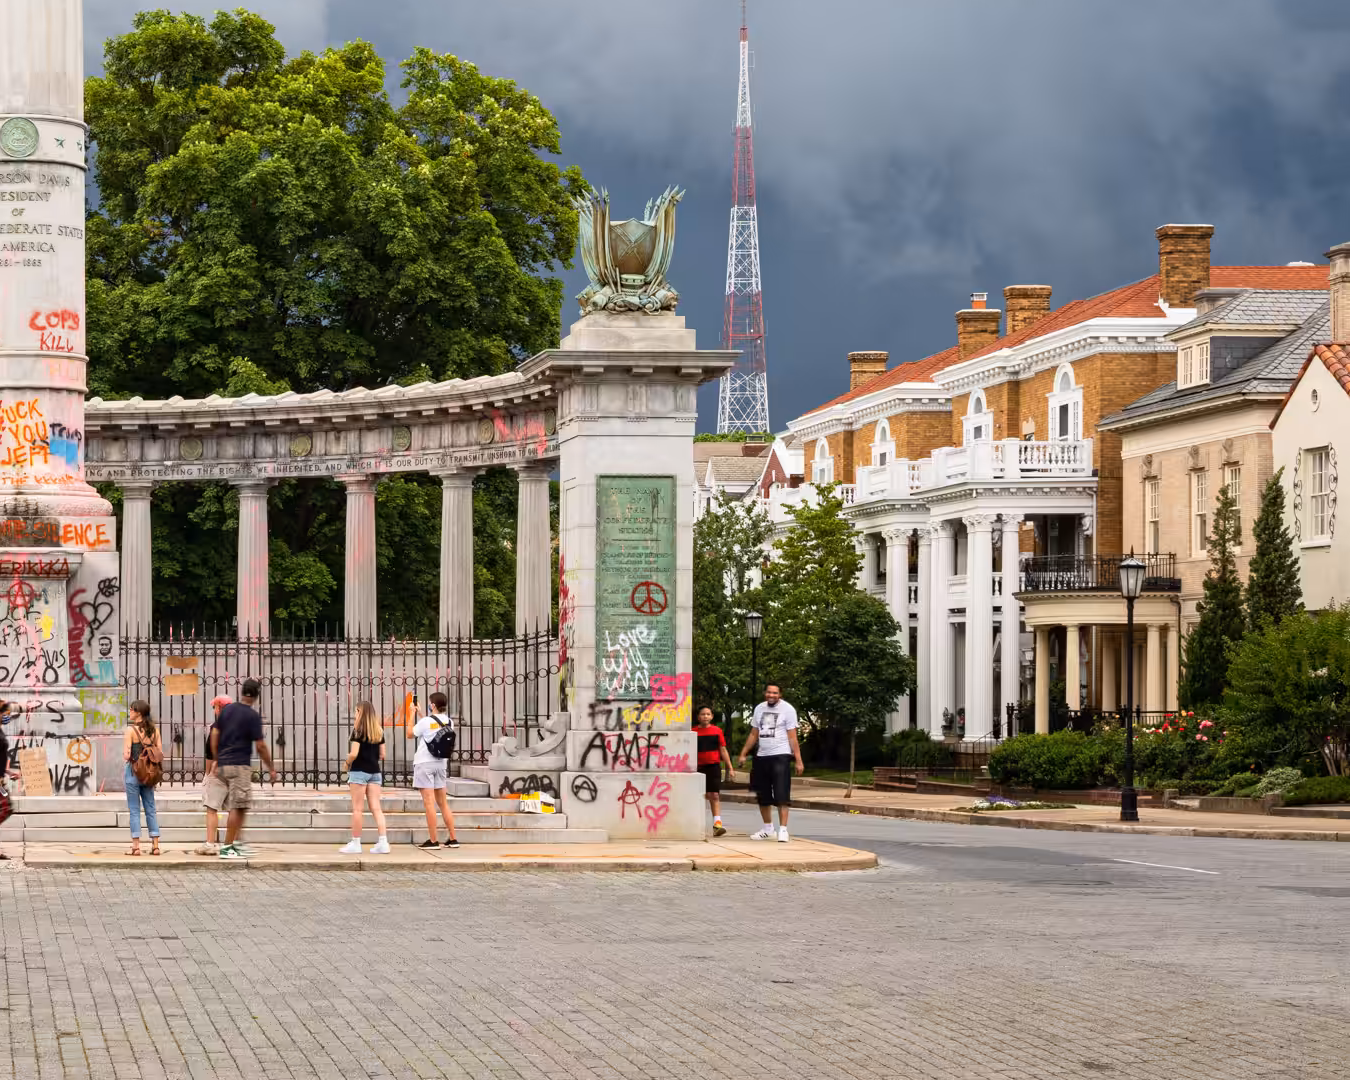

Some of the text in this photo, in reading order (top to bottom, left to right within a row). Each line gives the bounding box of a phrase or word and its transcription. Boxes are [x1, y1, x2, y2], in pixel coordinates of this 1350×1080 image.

[38, 173, 71, 187] DAVIS
[11, 208, 26, 216] OF
[57, 225, 84, 239] STATES
[0, 241, 56, 253] AMERICA
[29, 309, 80, 331] COPS
[40, 332, 73, 352] KILL
[8, 421, 48, 446] YOU
[0, 445, 53, 466] JEFF
[106, 469, 126, 478] AND
[130, 468, 193, 478] PROTECTING
[197, 467, 215, 476] THE
[219, 466, 253, 475] RIGHTS
[256, 465, 268, 474] WE
[325, 463, 342, 471] AND
[345, 461, 372, 470] WHICH
[374, 461, 382, 469] IT
[385, 460, 393, 468] IS
[396, 458, 412, 467] OUR
[415, 457, 434, 467] DUTY
[436, 456, 446, 465] TO
[450, 453, 485, 464] TRANSMIT
[487, 451, 516, 461] UNSHORN
[32, 520, 111, 547] SILENCE
